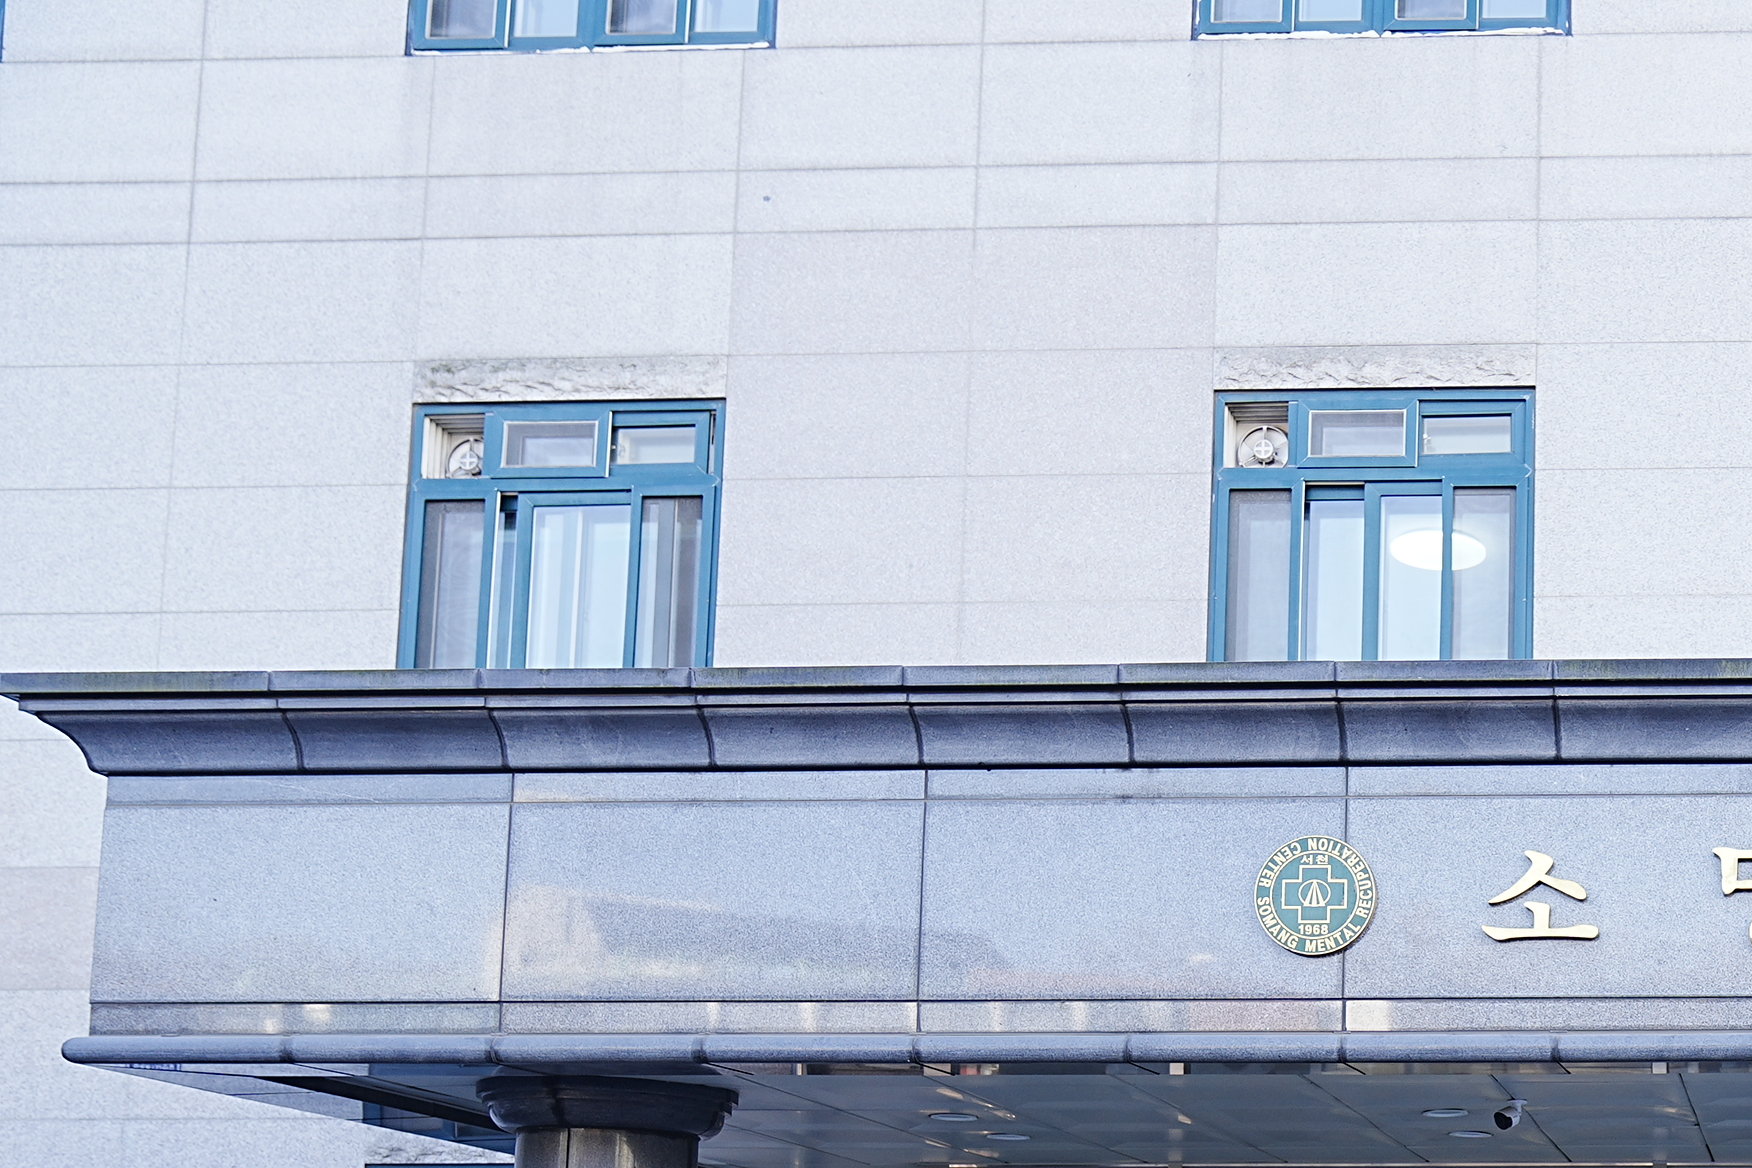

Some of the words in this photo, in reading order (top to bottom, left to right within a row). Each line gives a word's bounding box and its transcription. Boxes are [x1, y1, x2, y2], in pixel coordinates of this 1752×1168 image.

[1258, 841, 1302, 888] CENTER
[1307, 837, 1373, 919] RECUPERATION
[1257, 896, 1299, 949] SOMANG
[1298, 924, 1329, 935] 1968
[1304, 922, 1361, 953] MENTAL
